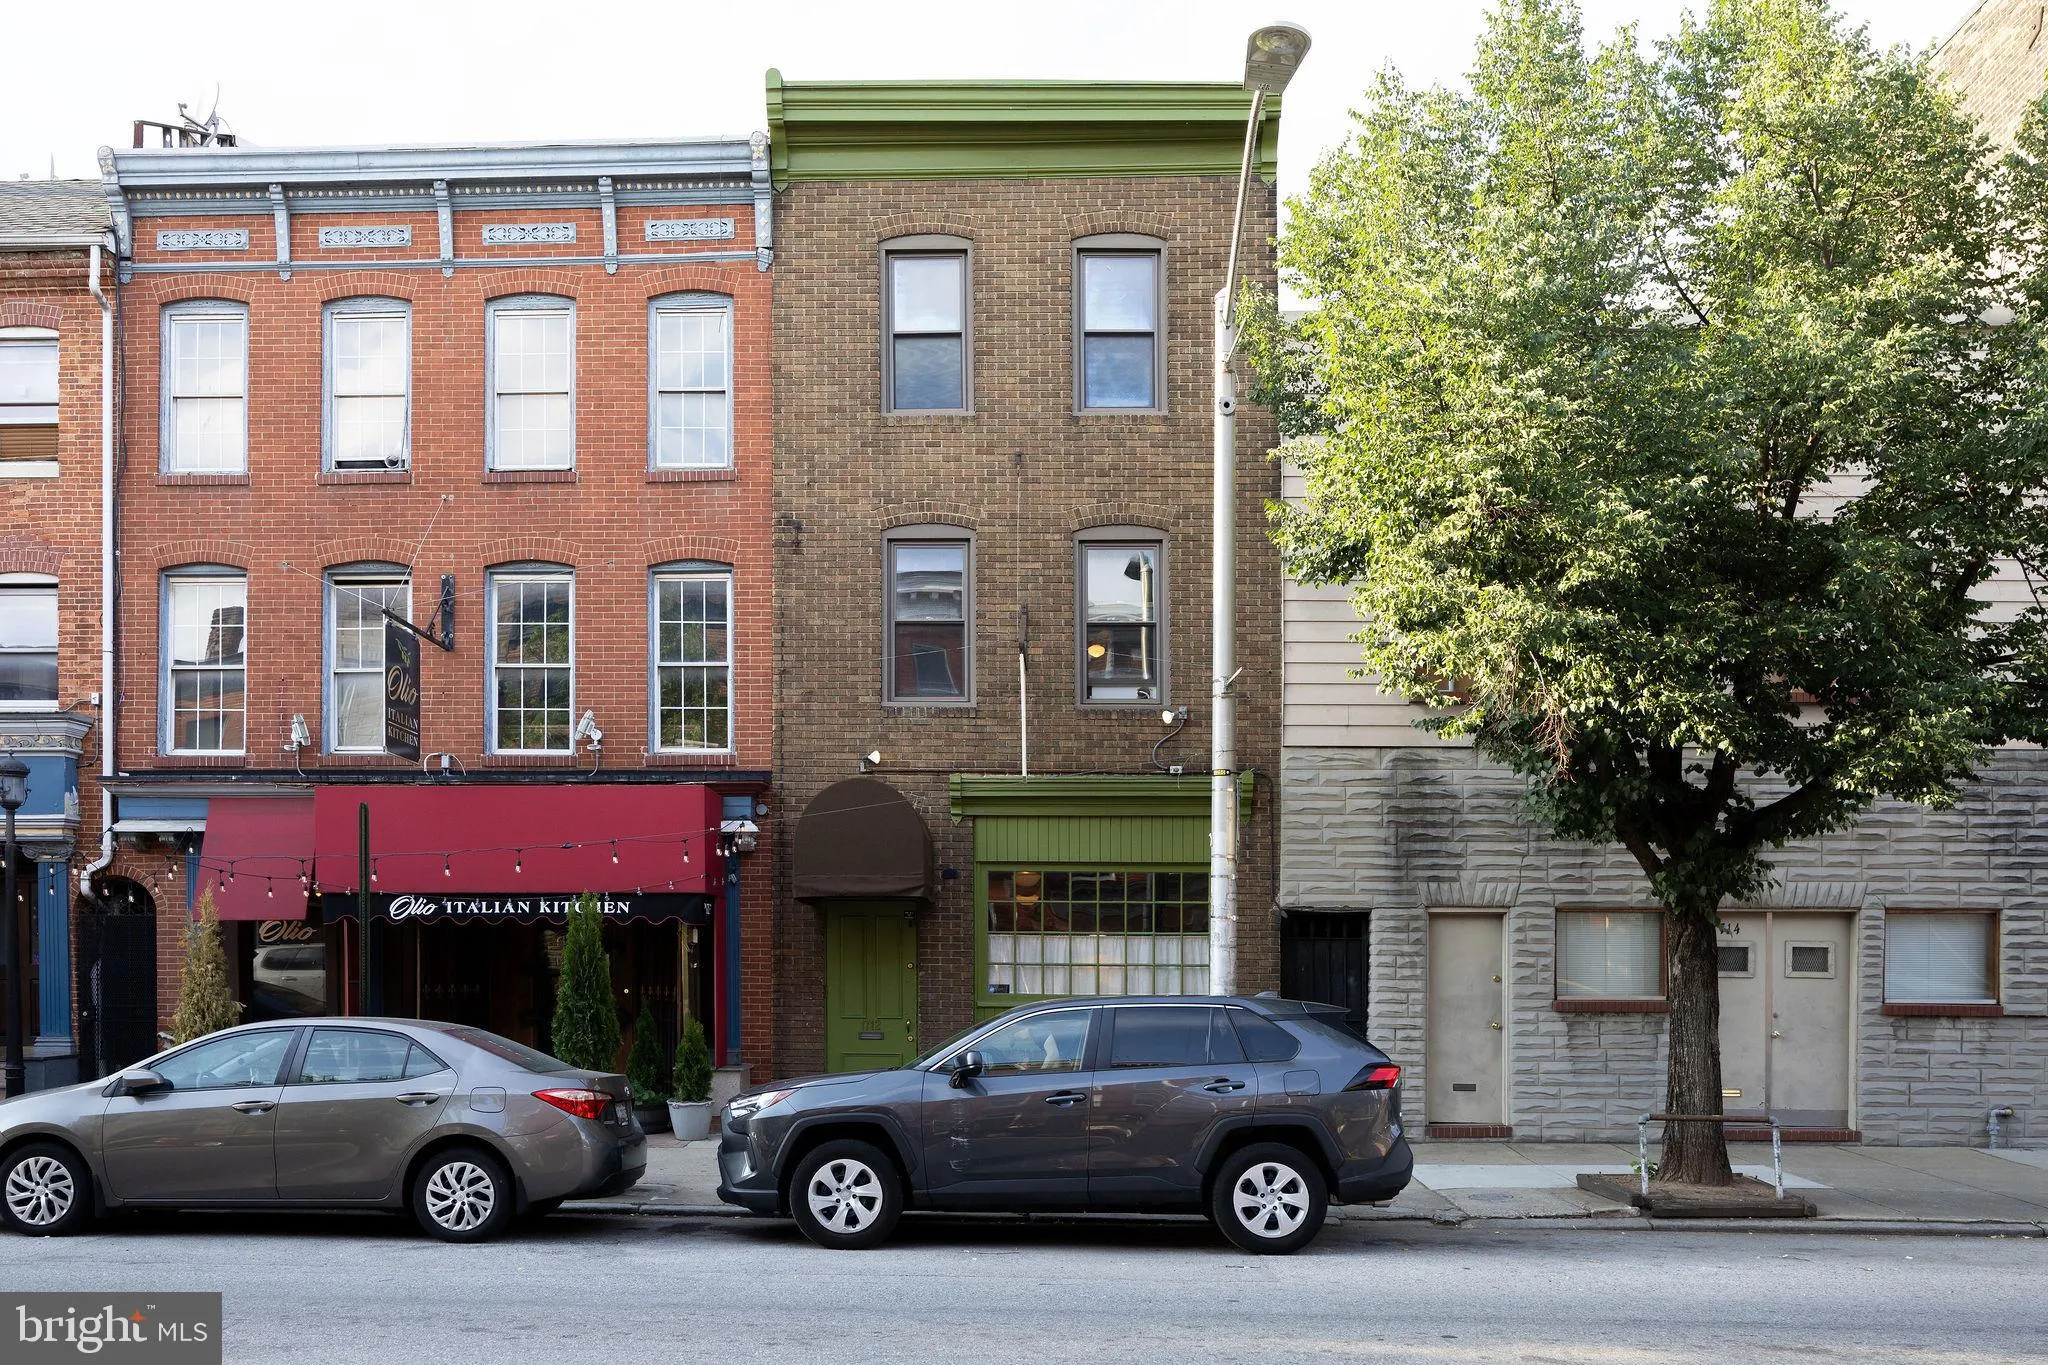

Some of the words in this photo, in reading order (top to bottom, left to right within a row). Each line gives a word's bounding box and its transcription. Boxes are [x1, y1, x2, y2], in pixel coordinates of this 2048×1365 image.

[387, 665, 418, 705] Olio
[388, 707, 418, 730] ITALIAN
[388, 725, 418, 747] KITCHEN
[389, 895, 438, 920] Olio
[446, 901, 531, 914] ITALIAN
[539, 901, 630, 914] KITCEN
[259, 919, 317, 942] Olio
